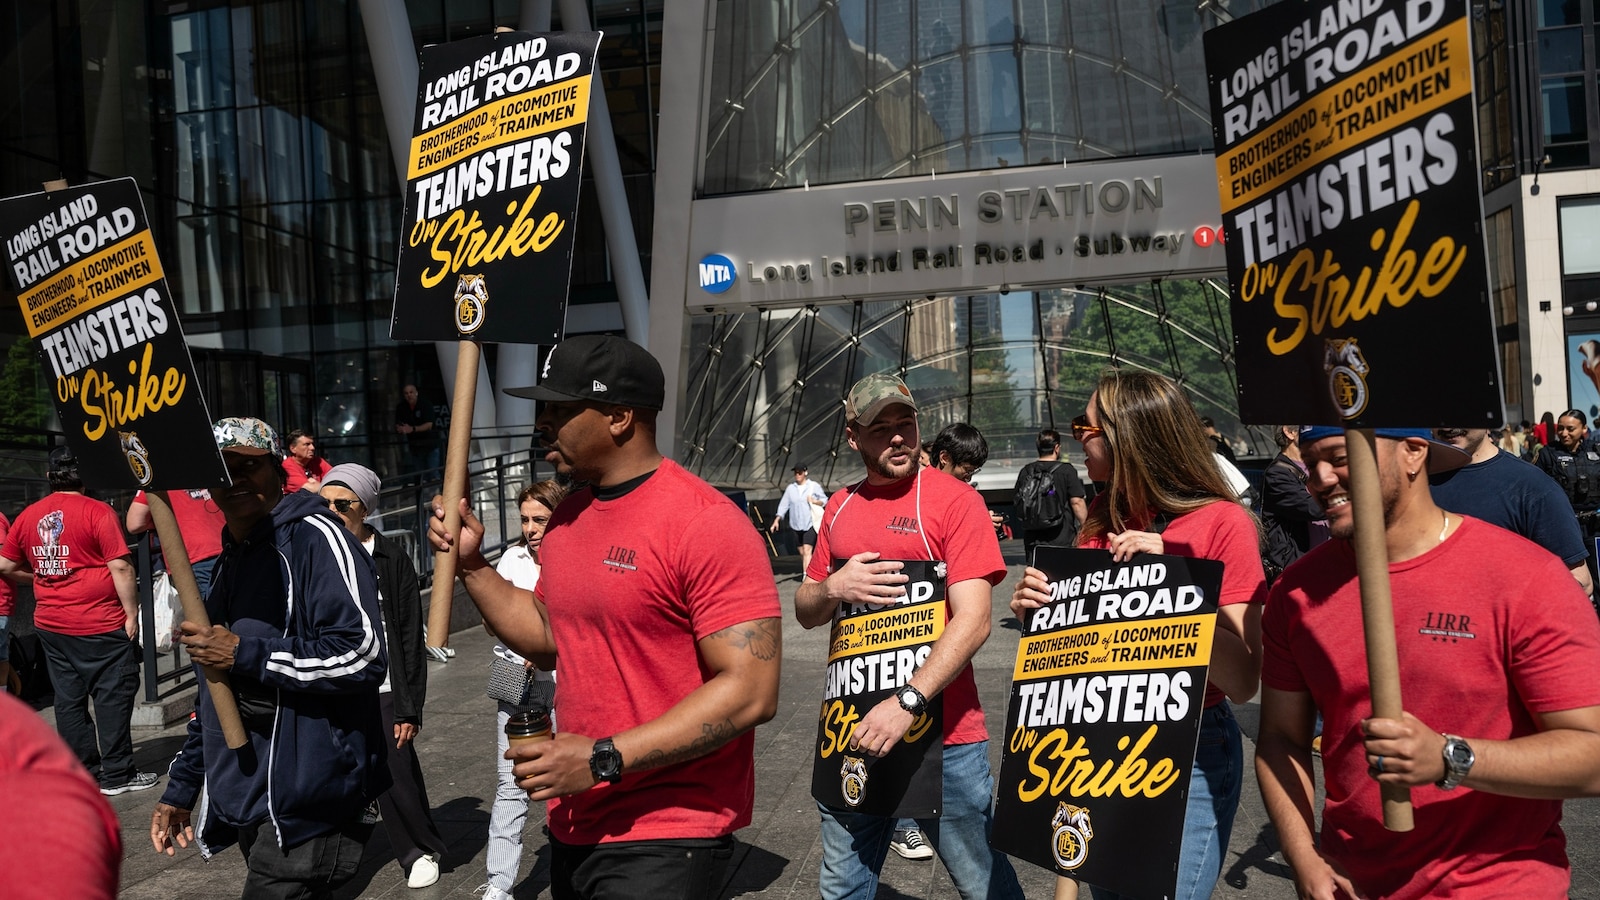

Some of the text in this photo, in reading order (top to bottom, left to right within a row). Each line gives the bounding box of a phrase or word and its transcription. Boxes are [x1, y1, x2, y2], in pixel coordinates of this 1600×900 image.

[421, 52, 581, 130] RAIL ROAD
[425, 37, 547, 103] LONG ISLAND
[1220, 50, 1278, 107] LONG
[1223, 0, 1446, 145] RAIL ROAD
[418, 104, 575, 170] ENGINEERS and TRAINMEN
[420, 85, 578, 153] BROTHERHOOD of LOCOMOTIVE
[1229, 38, 1450, 176] BROTHERHOOD of LOCOMOTIVE
[1231, 67, 1451, 199] ENGINEERS and TRAINMEN
[415, 131, 572, 223] TEAMSTERS
[844, 175, 1164, 236] PENN STATION
[1235, 112, 1458, 270] TEAMSTERS
[7, 193, 98, 262] LONG ISLAND
[13, 207, 136, 288] RAIL ROAD
[409, 185, 565, 289] On Strike
[747, 230, 1208, 285] Long Island Rail Road Subway 1
[27, 241, 146, 310] BROTHERHOOD of LOCOMOTIVE
[33, 260, 151, 329] ENGINEERS and TRAINMEN
[699, 263, 731, 287] MTA
[1241, 199, 1467, 356] On Strike
[41, 288, 168, 379] TEAMSTERS
[57, 342, 186, 441] On Strike
[608, 546, 636, 564] LIRR
[891, 516, 917, 530] LIRR
[1030, 585, 1204, 632] RAIL ROAD
[1048, 562, 1167, 602] ONG ISLAND
[857, 622, 864, 637] of
[865, 608, 934, 632] LOCOMOTIVE
[865, 623, 934, 646] TRAINMEN
[1026, 622, 1201, 655] BROTHERHOOD of LOCOMOTIVE
[1426, 612, 1470, 631] LIRR
[1022, 642, 1198, 673] ENGINEERS and TRAINMEN
[1017, 670, 1192, 728] TEAMSTERS
[1010, 724, 1181, 803] On Strike
